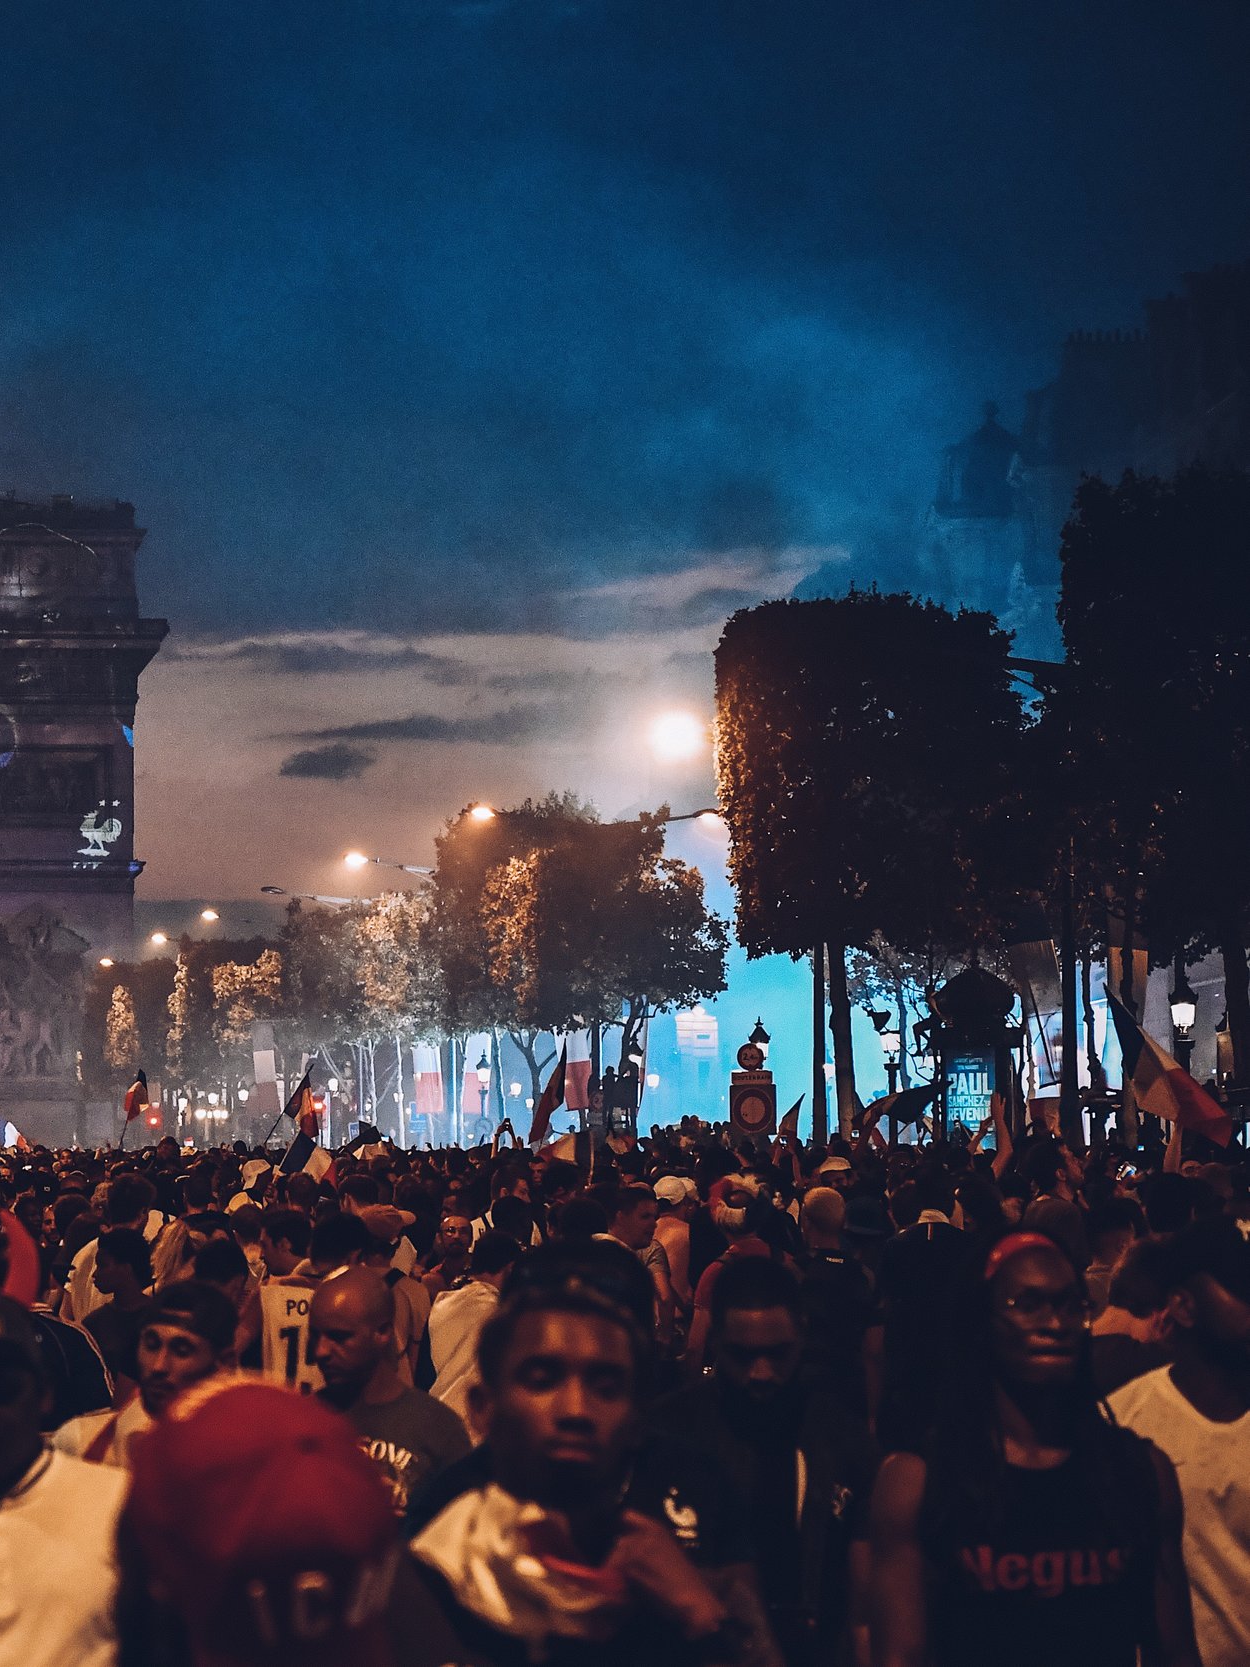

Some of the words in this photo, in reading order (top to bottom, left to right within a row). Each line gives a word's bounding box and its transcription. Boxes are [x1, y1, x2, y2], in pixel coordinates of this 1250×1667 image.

[947, 1072, 993, 1095] PAUL
[948, 1095, 985, 1107] SANCHEZ
[286, 1299, 309, 1316] PO
